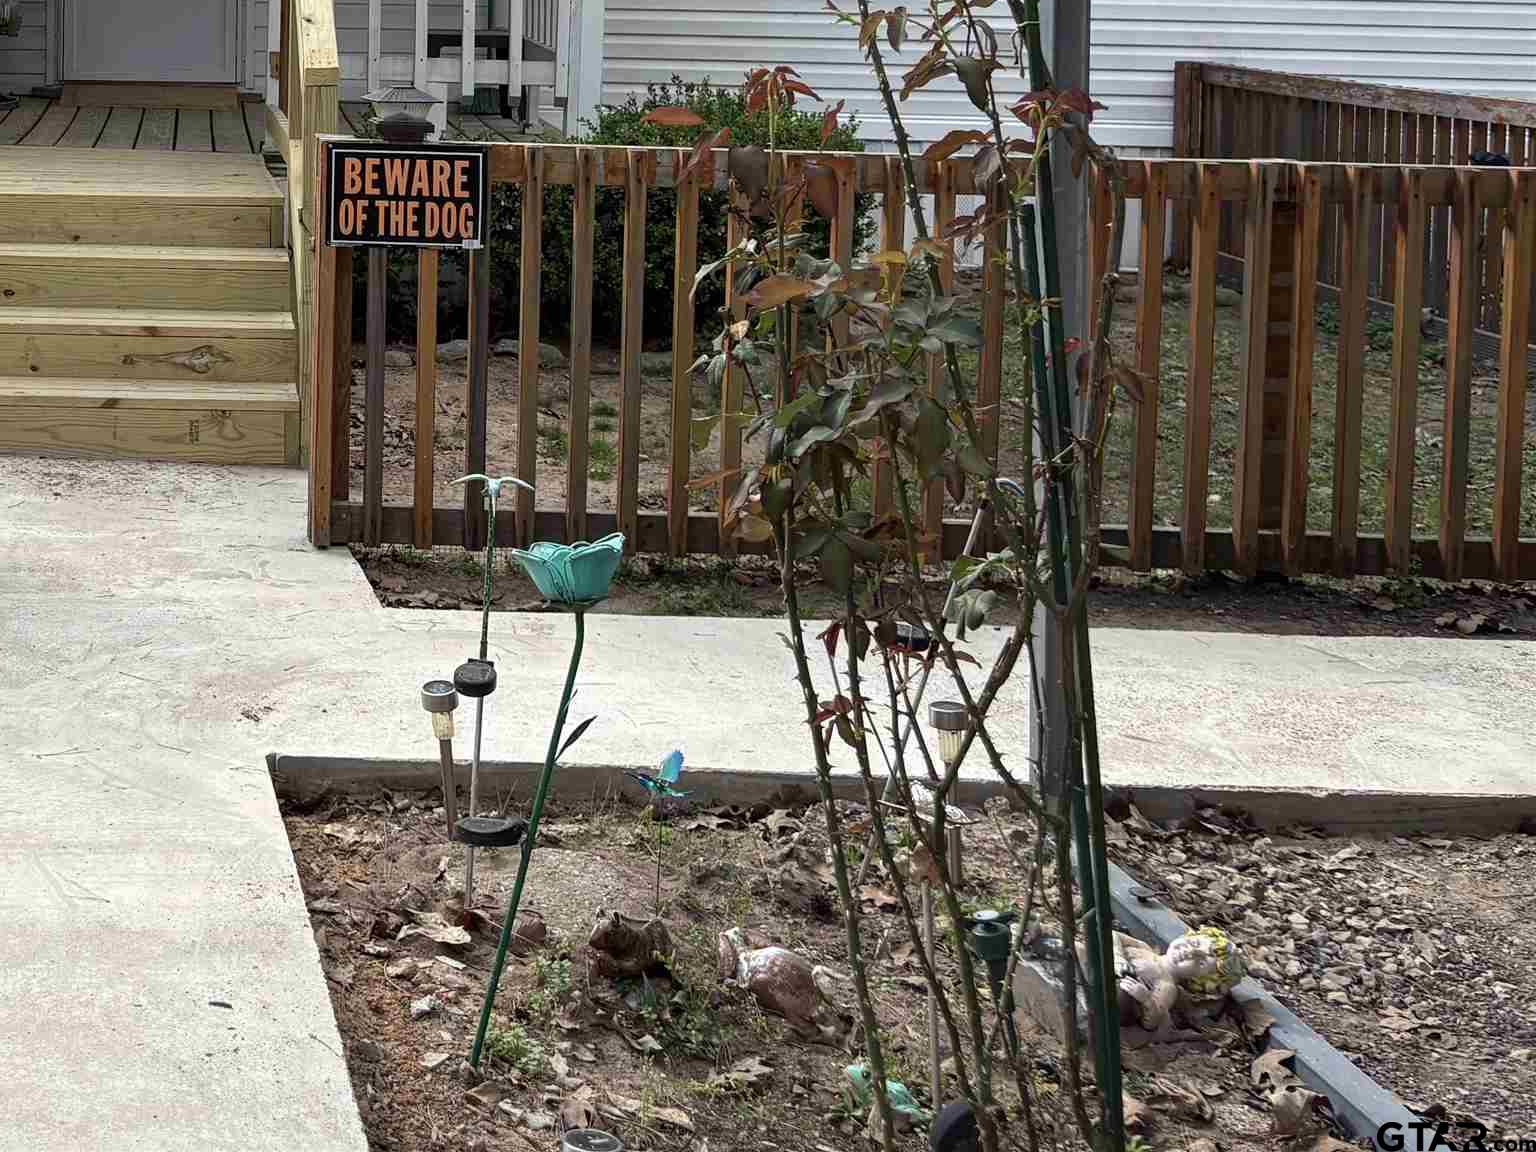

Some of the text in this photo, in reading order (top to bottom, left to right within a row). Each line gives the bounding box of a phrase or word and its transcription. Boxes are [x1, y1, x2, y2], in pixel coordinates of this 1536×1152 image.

[344, 157, 470, 198] BEWARE
[338, 199, 474, 239] OF THE DOG
